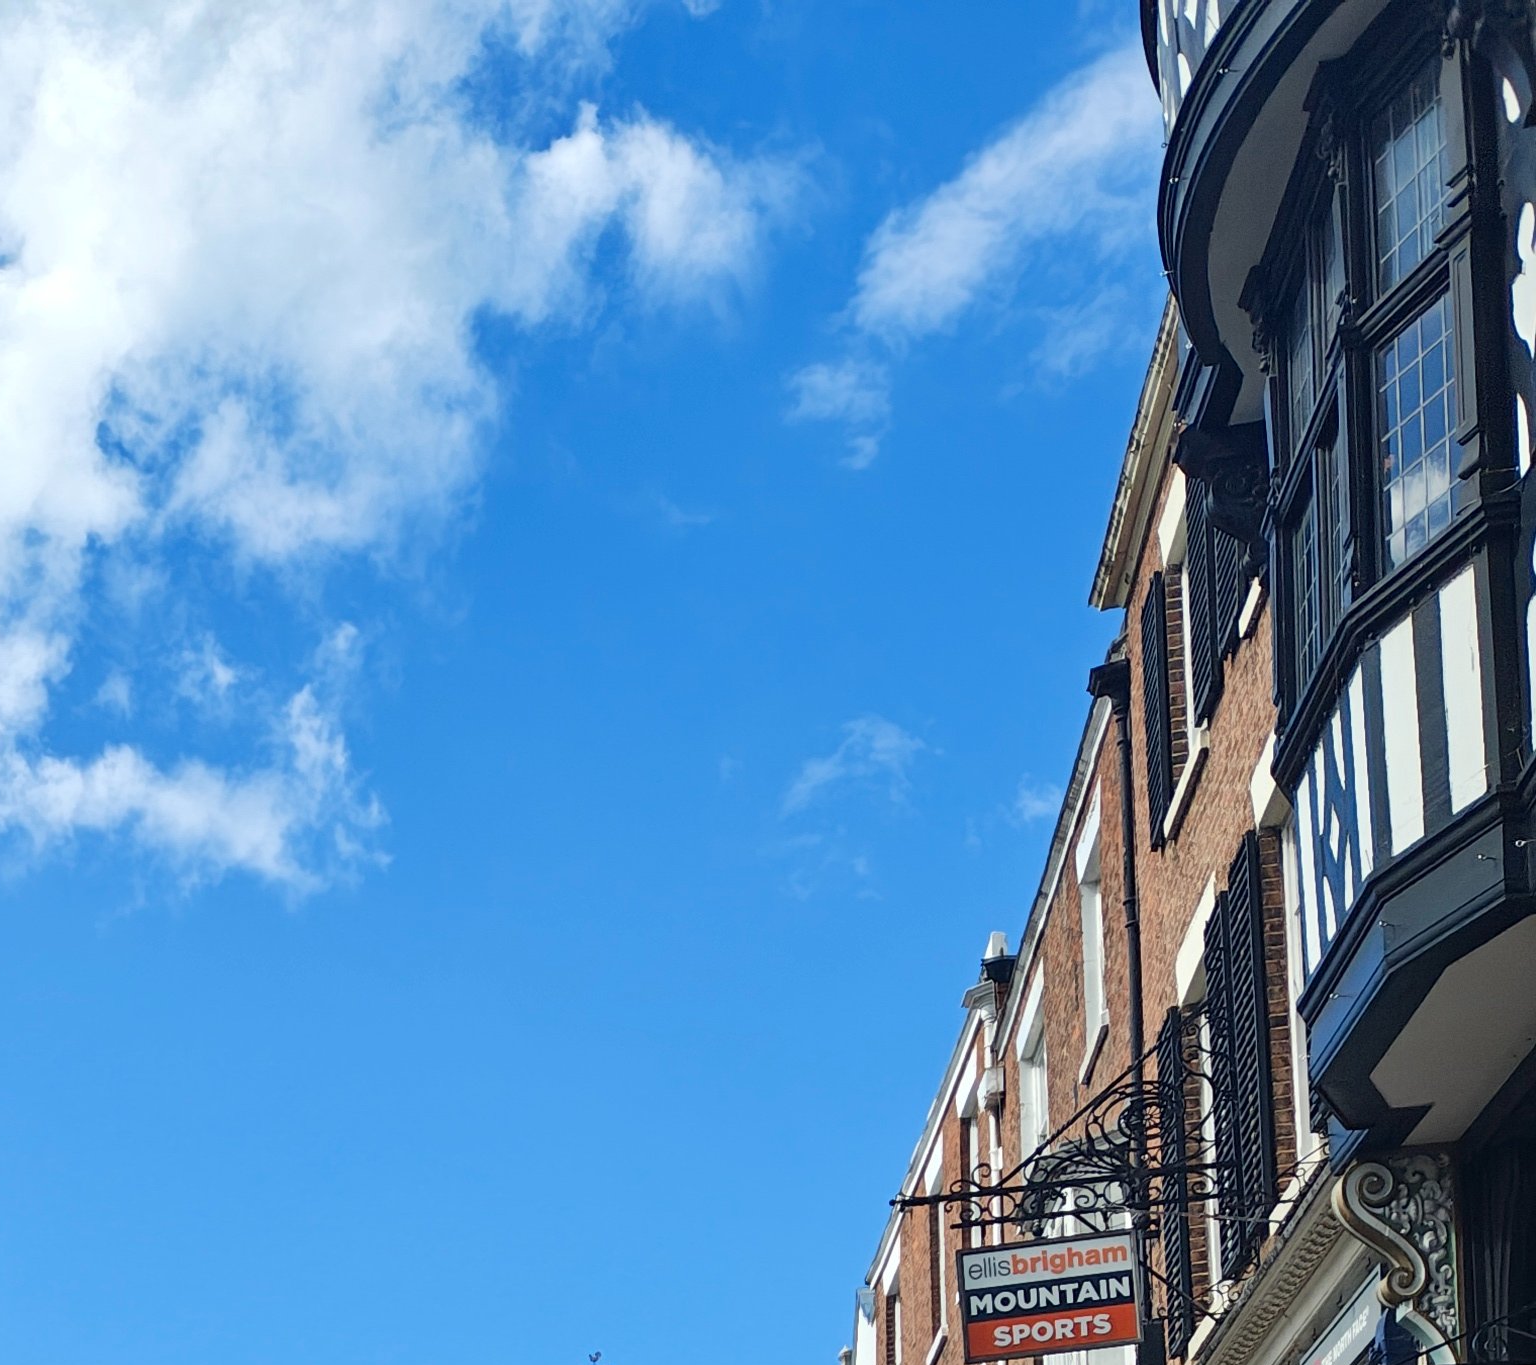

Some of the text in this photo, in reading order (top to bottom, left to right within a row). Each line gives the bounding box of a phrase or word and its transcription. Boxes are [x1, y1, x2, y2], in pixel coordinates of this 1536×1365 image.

[969, 1244, 1127, 1280] ellisbrigham
[970, 1276, 1131, 1316] MOUNTAIN
[993, 1314, 1112, 1347] SPORTS
[1333, 1327, 1352, 1362] NORTH
